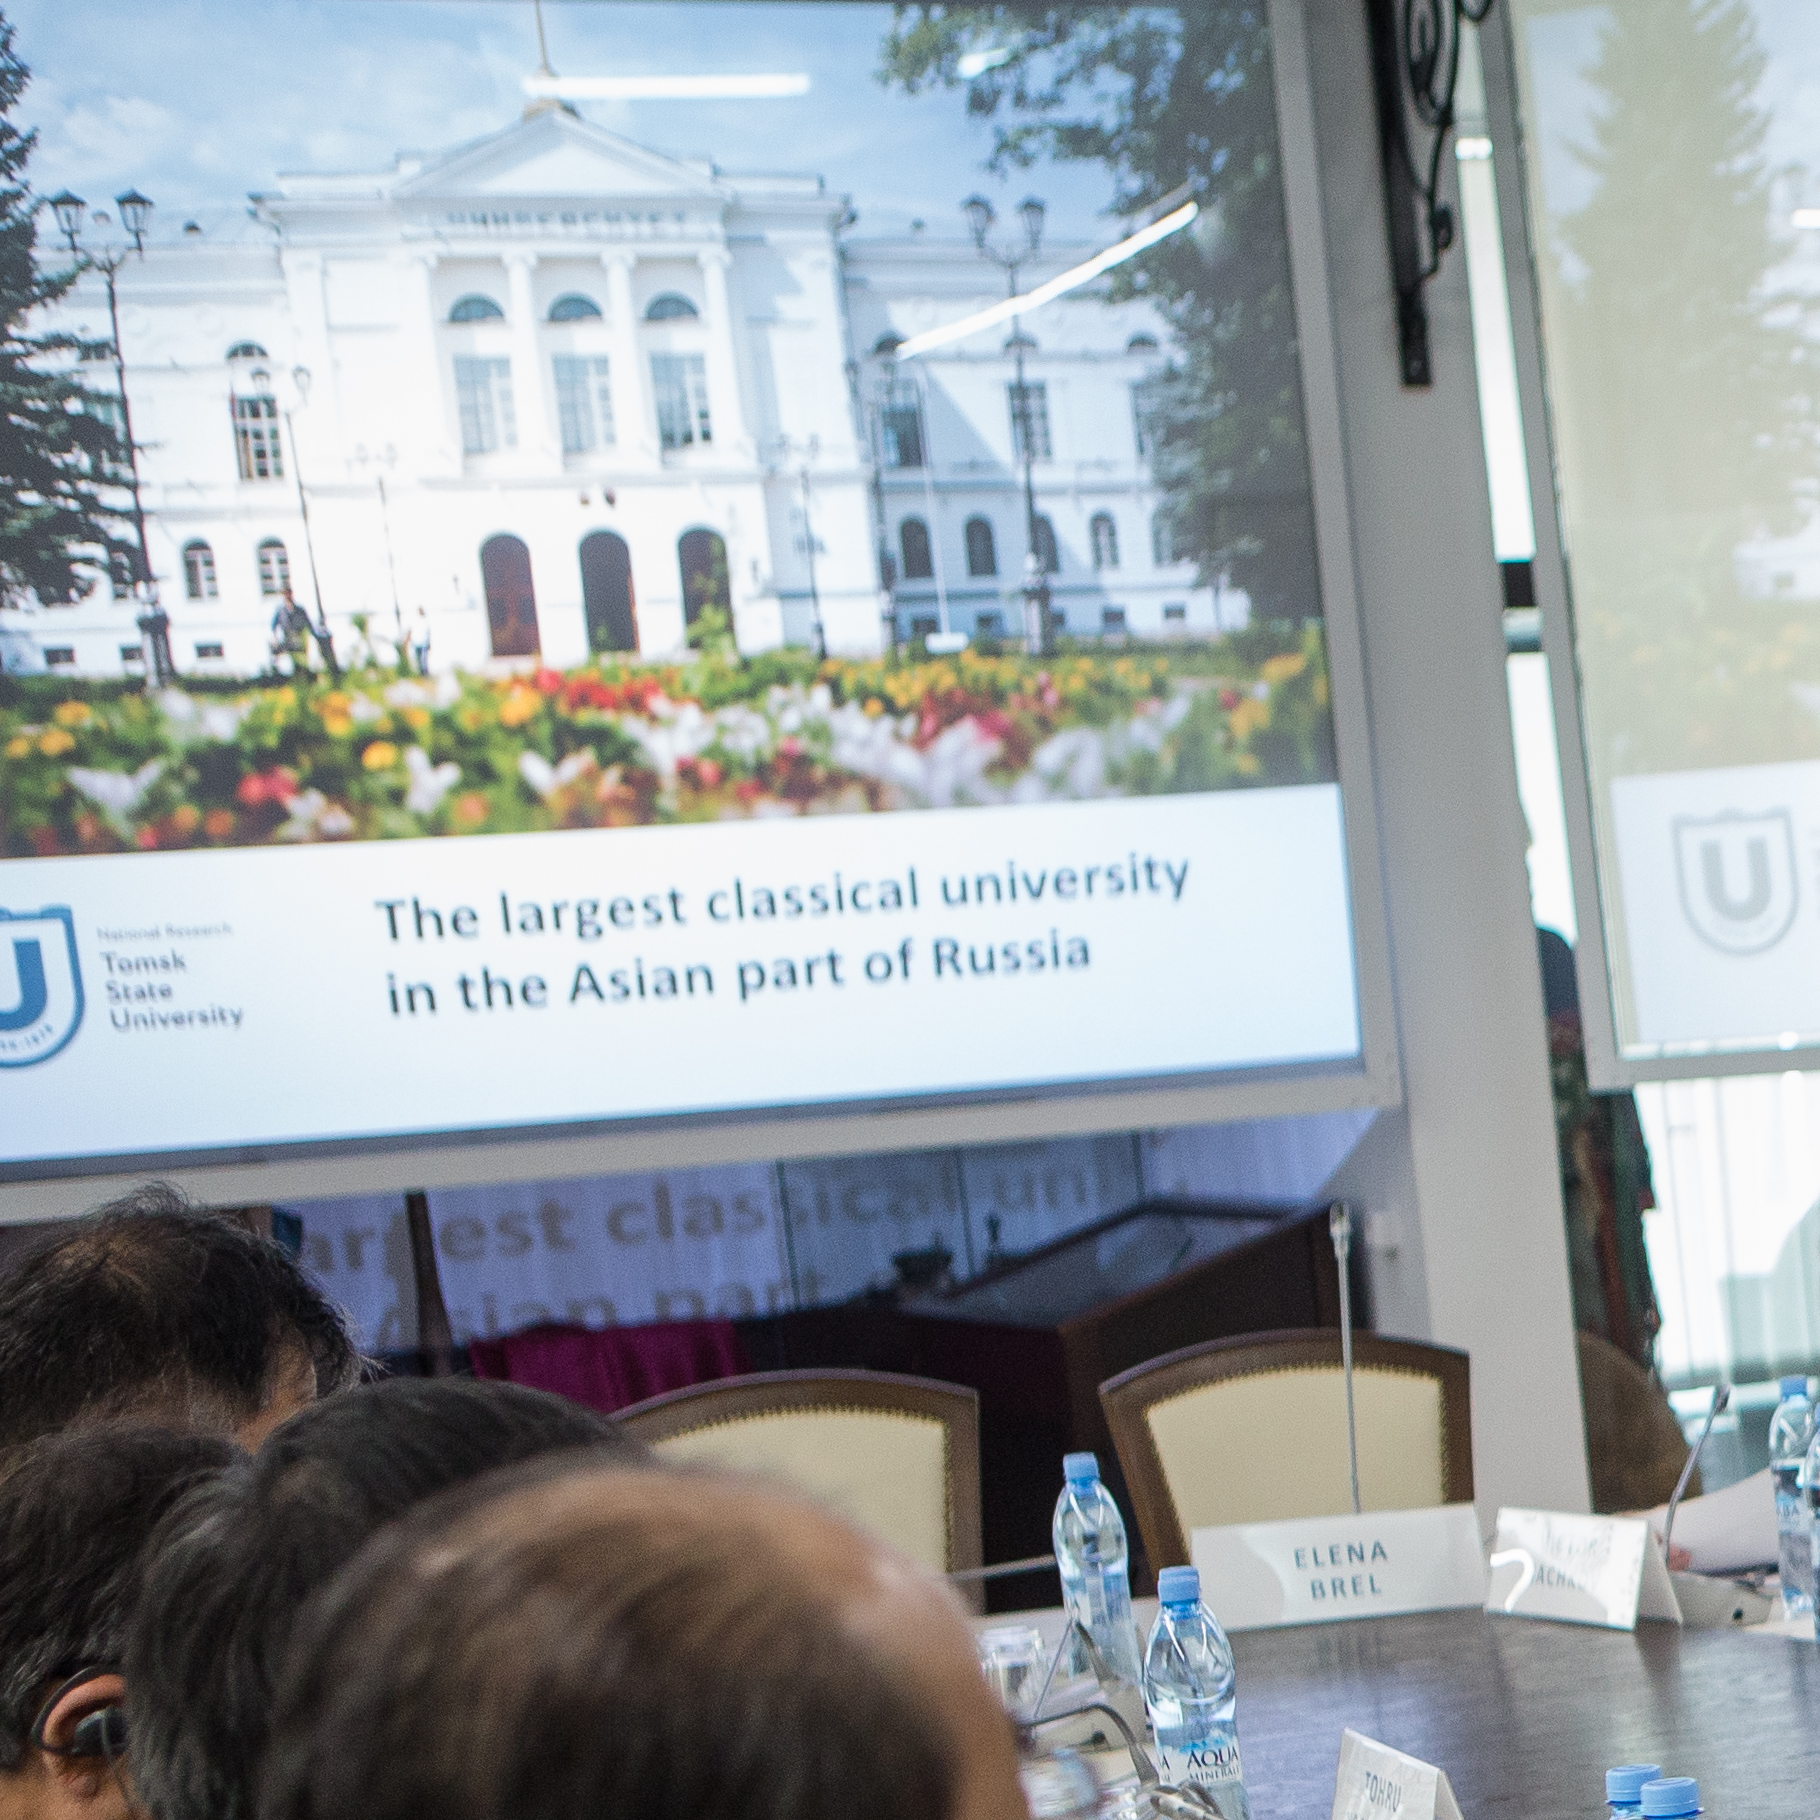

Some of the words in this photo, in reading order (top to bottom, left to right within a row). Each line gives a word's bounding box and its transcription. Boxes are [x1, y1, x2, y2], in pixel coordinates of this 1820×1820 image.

[374, 896, 479, 941] The
[499, 889, 687, 942] largest
[707, 866, 919, 925] classical
[941, 851, 1189, 903] university
[101, 949, 187, 976] Tomsk
[386, 973, 437, 1016] in
[457, 964, 548, 1011] the
[569, 956, 715, 1006] Asian
[737, 948, 844, 1006] part
[864, 936, 913, 983] of
[933, 928, 1091, 979] Russia
[105, 979, 174, 1004] State
[110, 1003, 243, 1034] University
[1294, 1540, 1387, 1569] ELENA
[1311, 1573, 1382, 1600] BREL
[1187, 1746, 1239, 1769] AQUA
[1366, 1770, 1402, 1813] TOHRU
